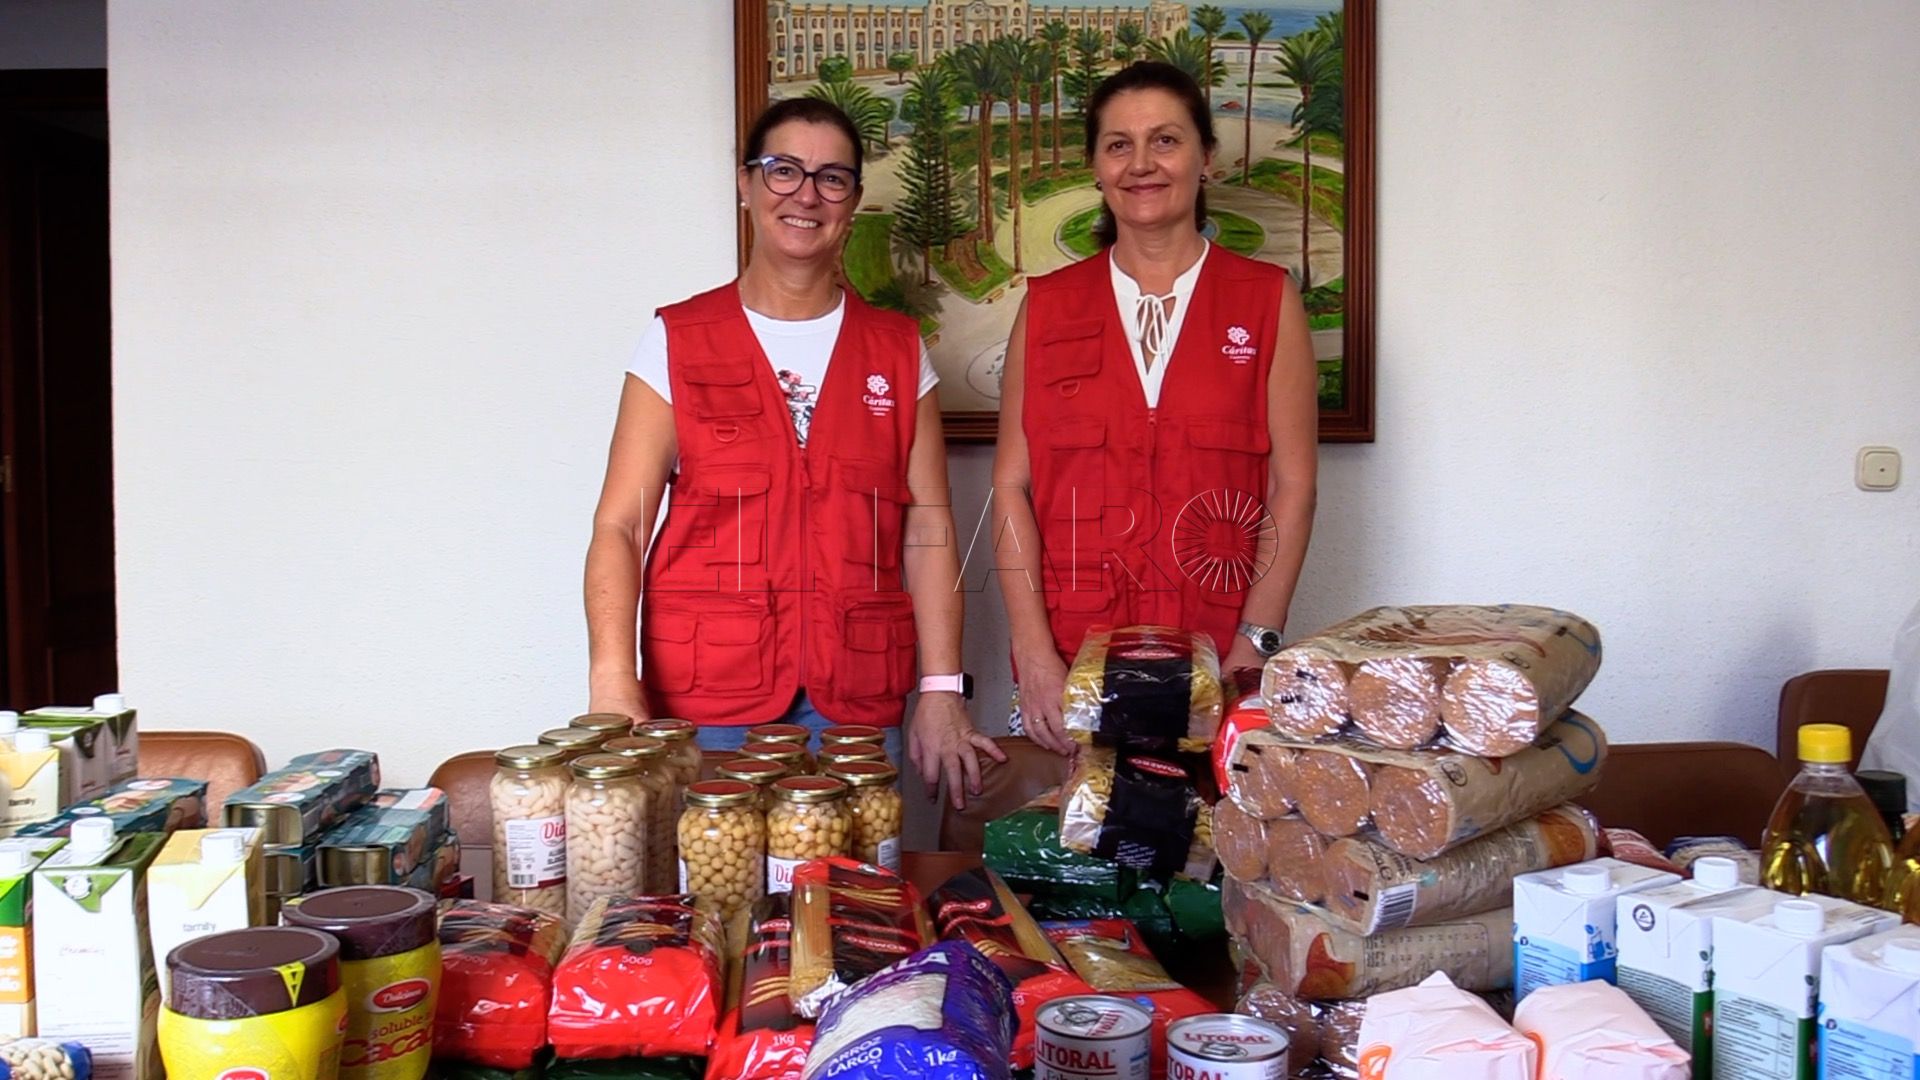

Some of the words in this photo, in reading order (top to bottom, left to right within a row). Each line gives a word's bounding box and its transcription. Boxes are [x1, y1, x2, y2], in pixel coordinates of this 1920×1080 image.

[828, 1036, 883, 1067] ARROZ
[1183, 1032, 1272, 1044] LITORAL
[827, 1046, 883, 1077] LARGO
